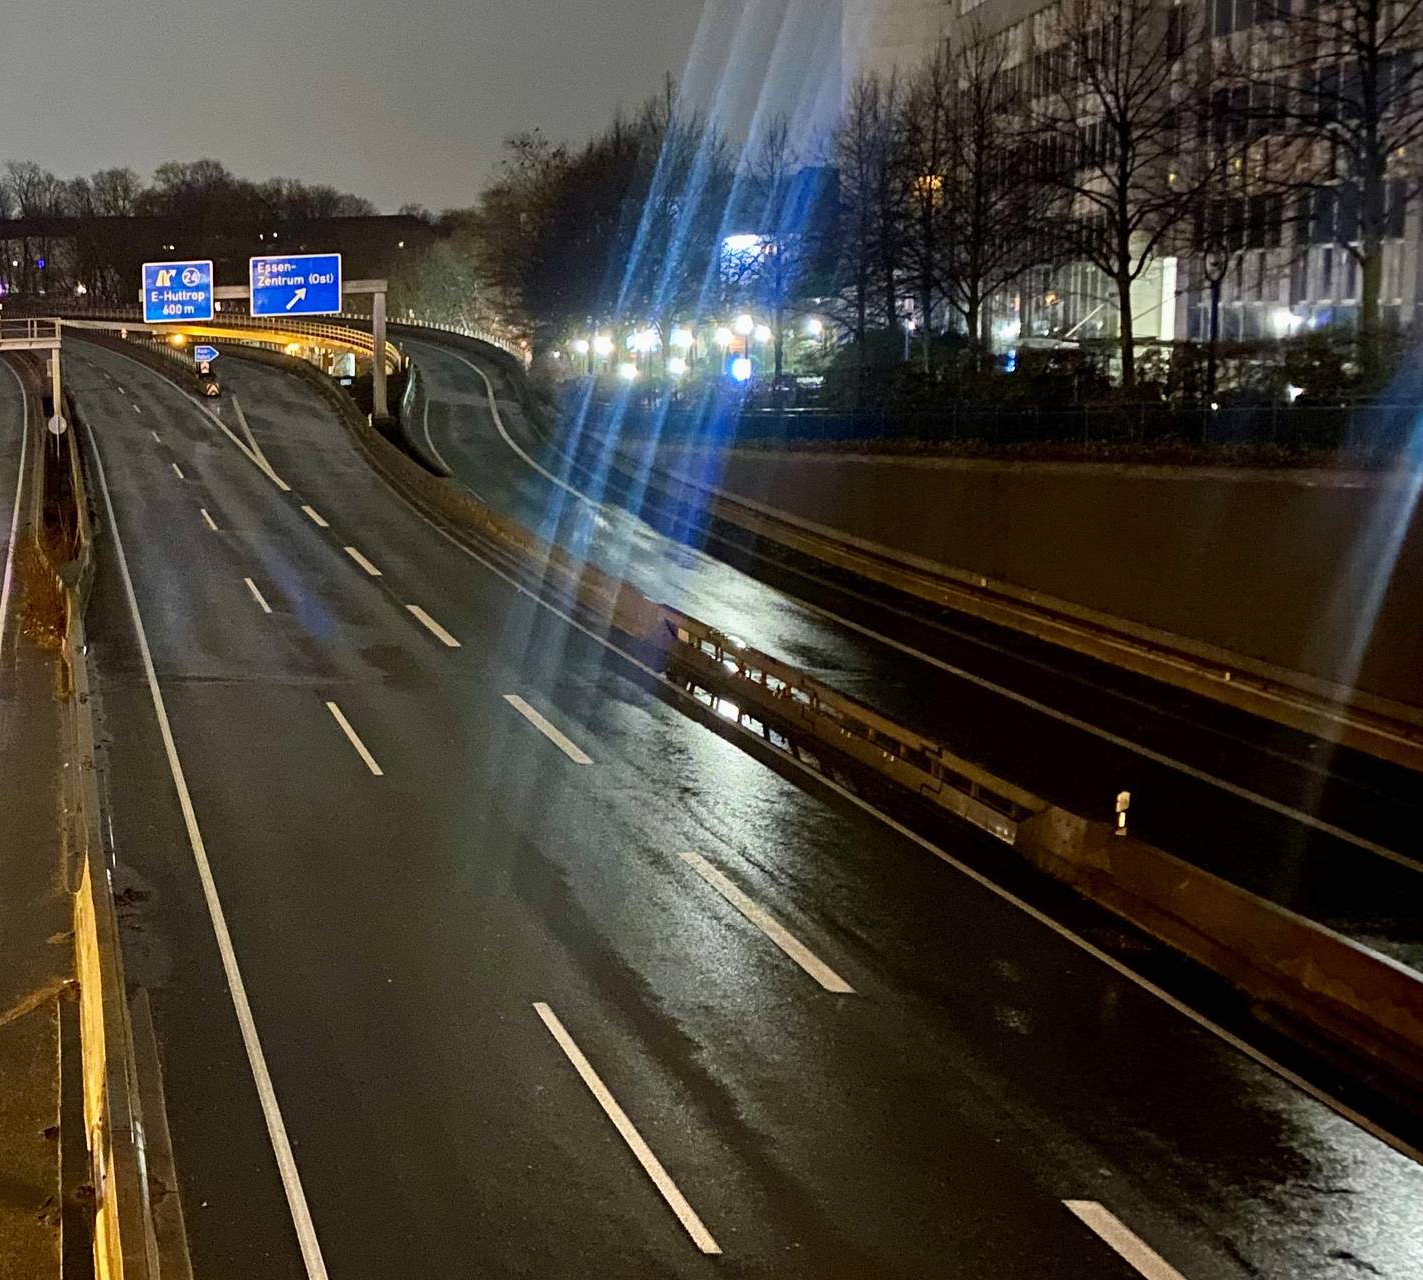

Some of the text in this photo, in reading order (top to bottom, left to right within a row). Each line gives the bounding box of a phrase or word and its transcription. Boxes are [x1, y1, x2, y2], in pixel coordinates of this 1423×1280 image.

[257, 262, 296, 273] Essen-
[183, 271, 200, 283] 24
[258, 273, 334, 286] Zentrum (Ost)
[151, 290, 205, 302] E-Huttrop
[162, 304, 194, 315] 600 m
